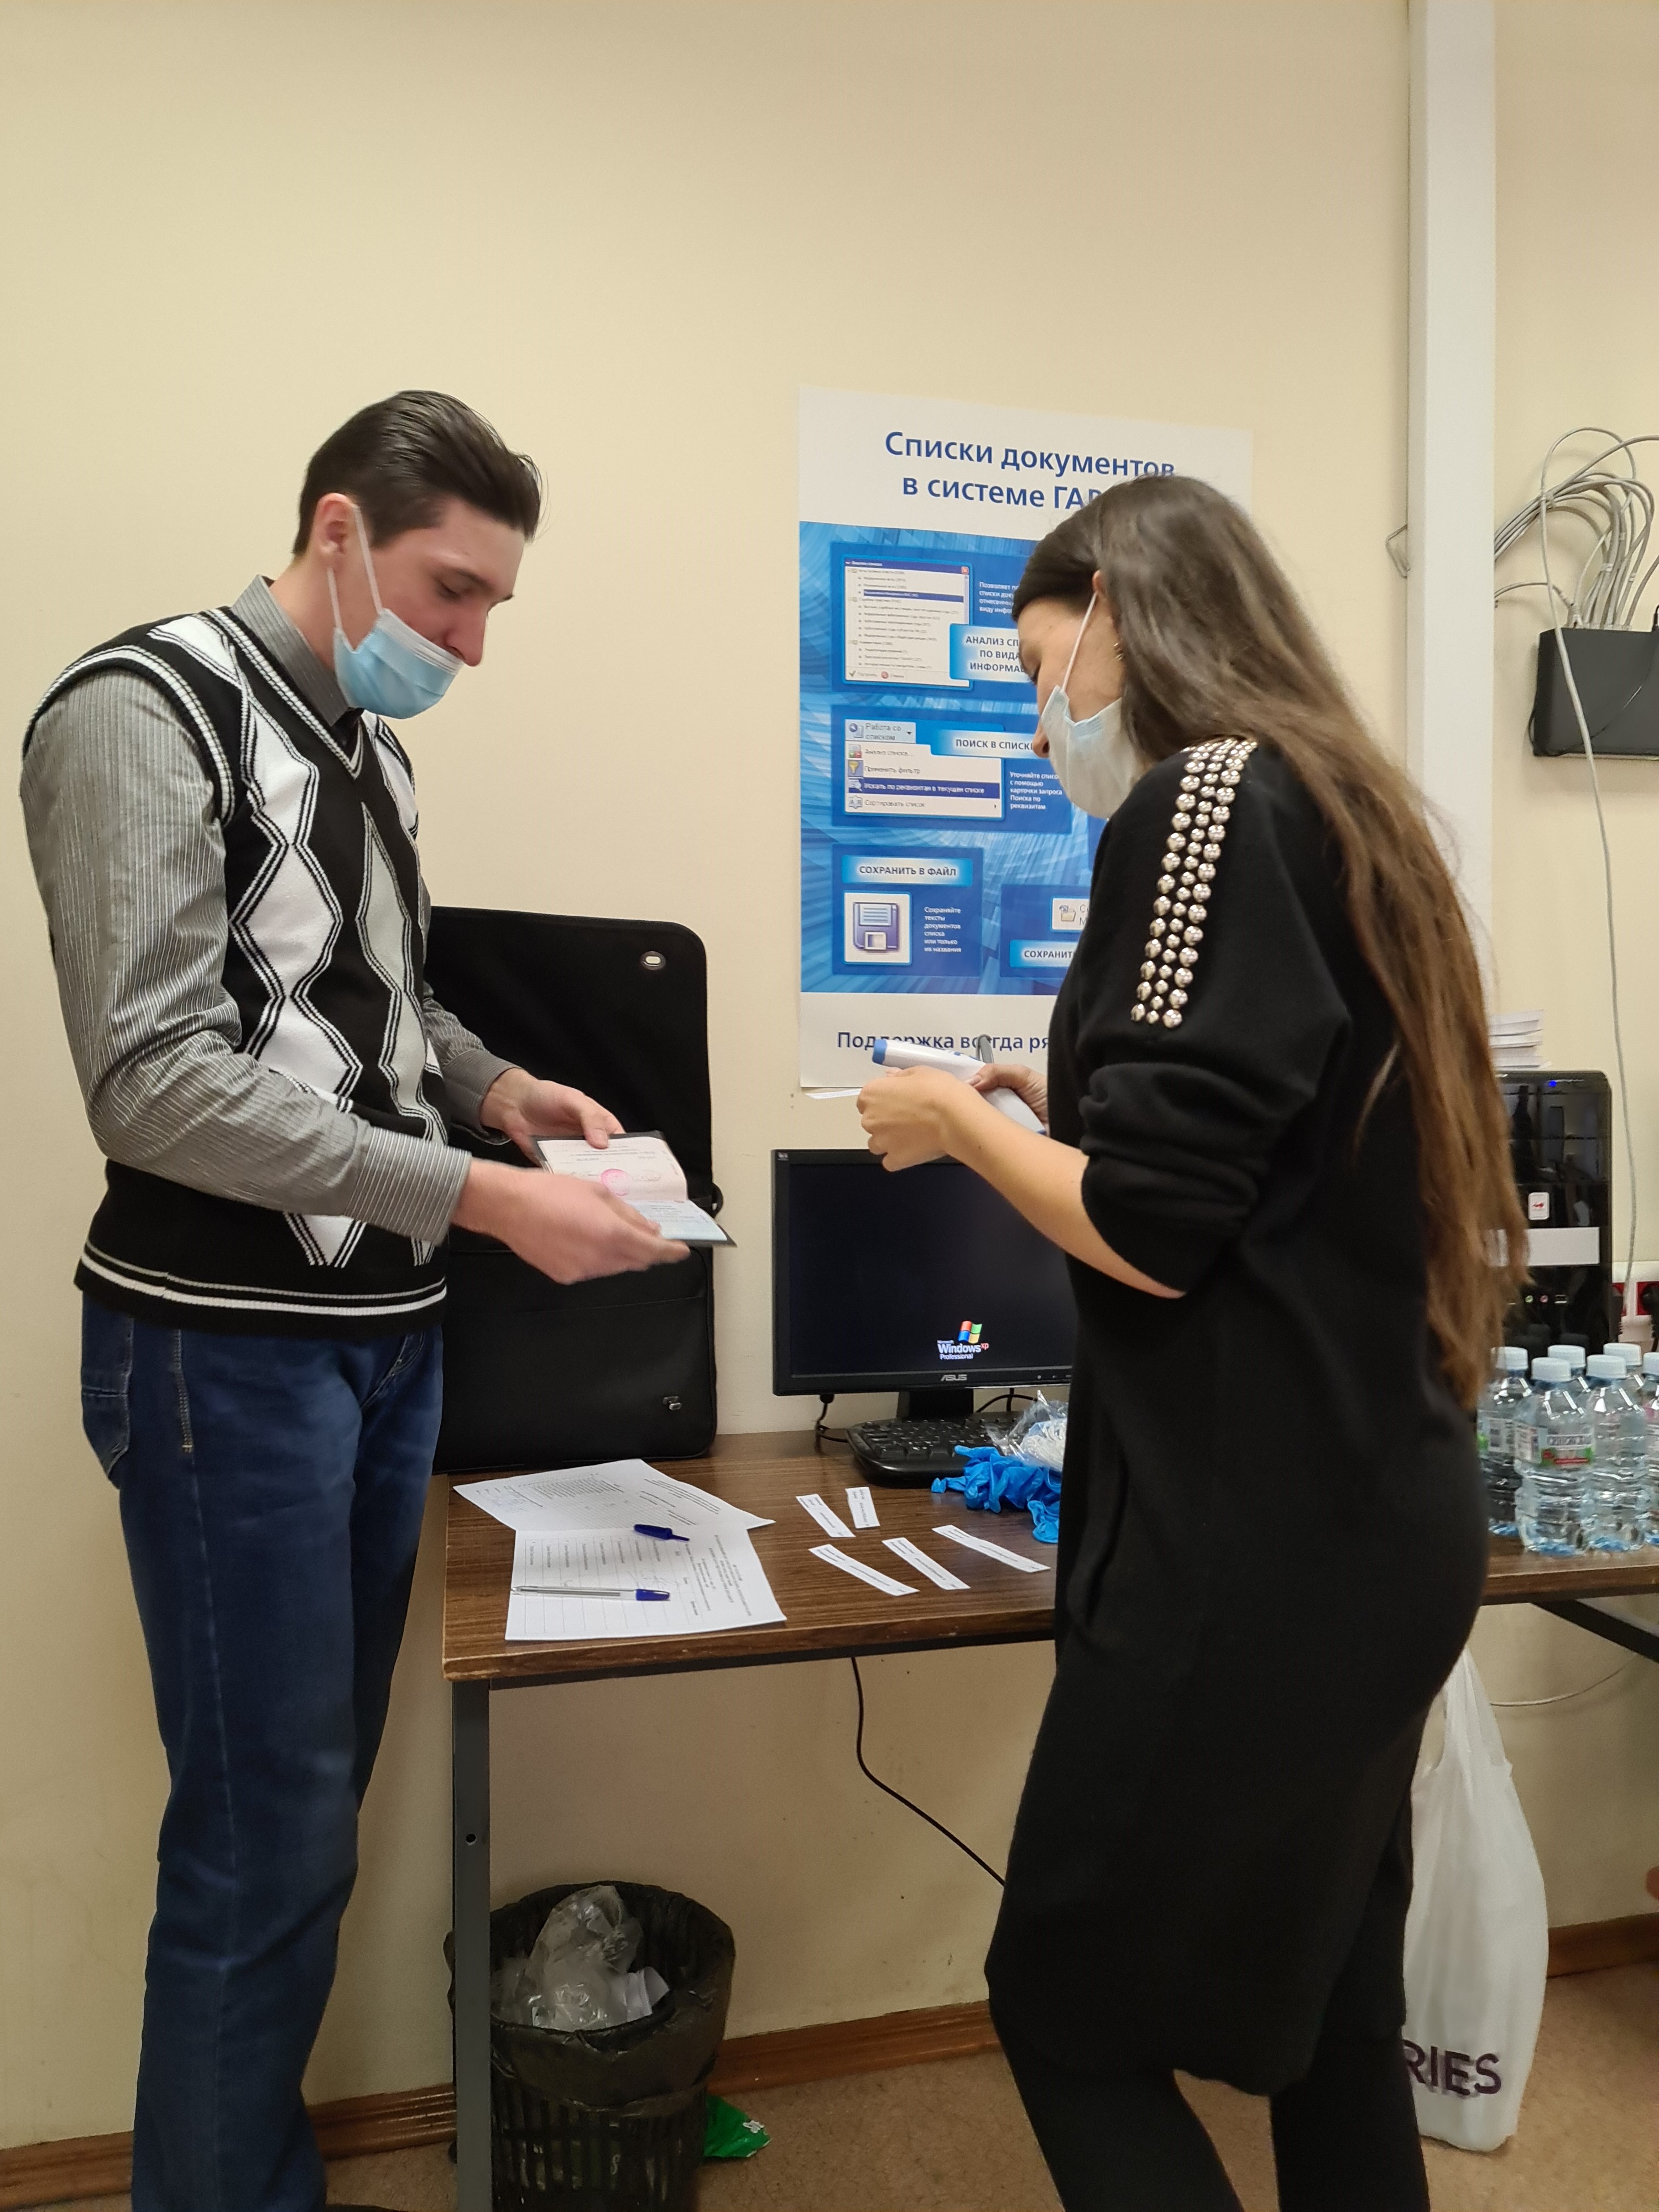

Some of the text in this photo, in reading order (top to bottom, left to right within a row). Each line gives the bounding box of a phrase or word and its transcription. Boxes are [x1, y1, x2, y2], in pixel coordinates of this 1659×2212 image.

[885, 431, 1175, 477] Списки документов
[902, 477, 919, 495] в
[927, 478, 1045, 507] системе
[966, 635, 1004, 646] АНАЛИЗ
[979, 650, 993, 658] ПО
[955, 739, 989, 748] ПОИСК
[859, 865, 916, 875] СОХРАНИТЬ
[927, 866, 957, 876] ФАЙЛ
[1024, 950, 1074, 958] СОХРАНИТ
[837, 1031, 954, 1051] Поджка
[960, 1036, 1023, 1051] всгда
[937, 1343, 982, 1354] Windows
